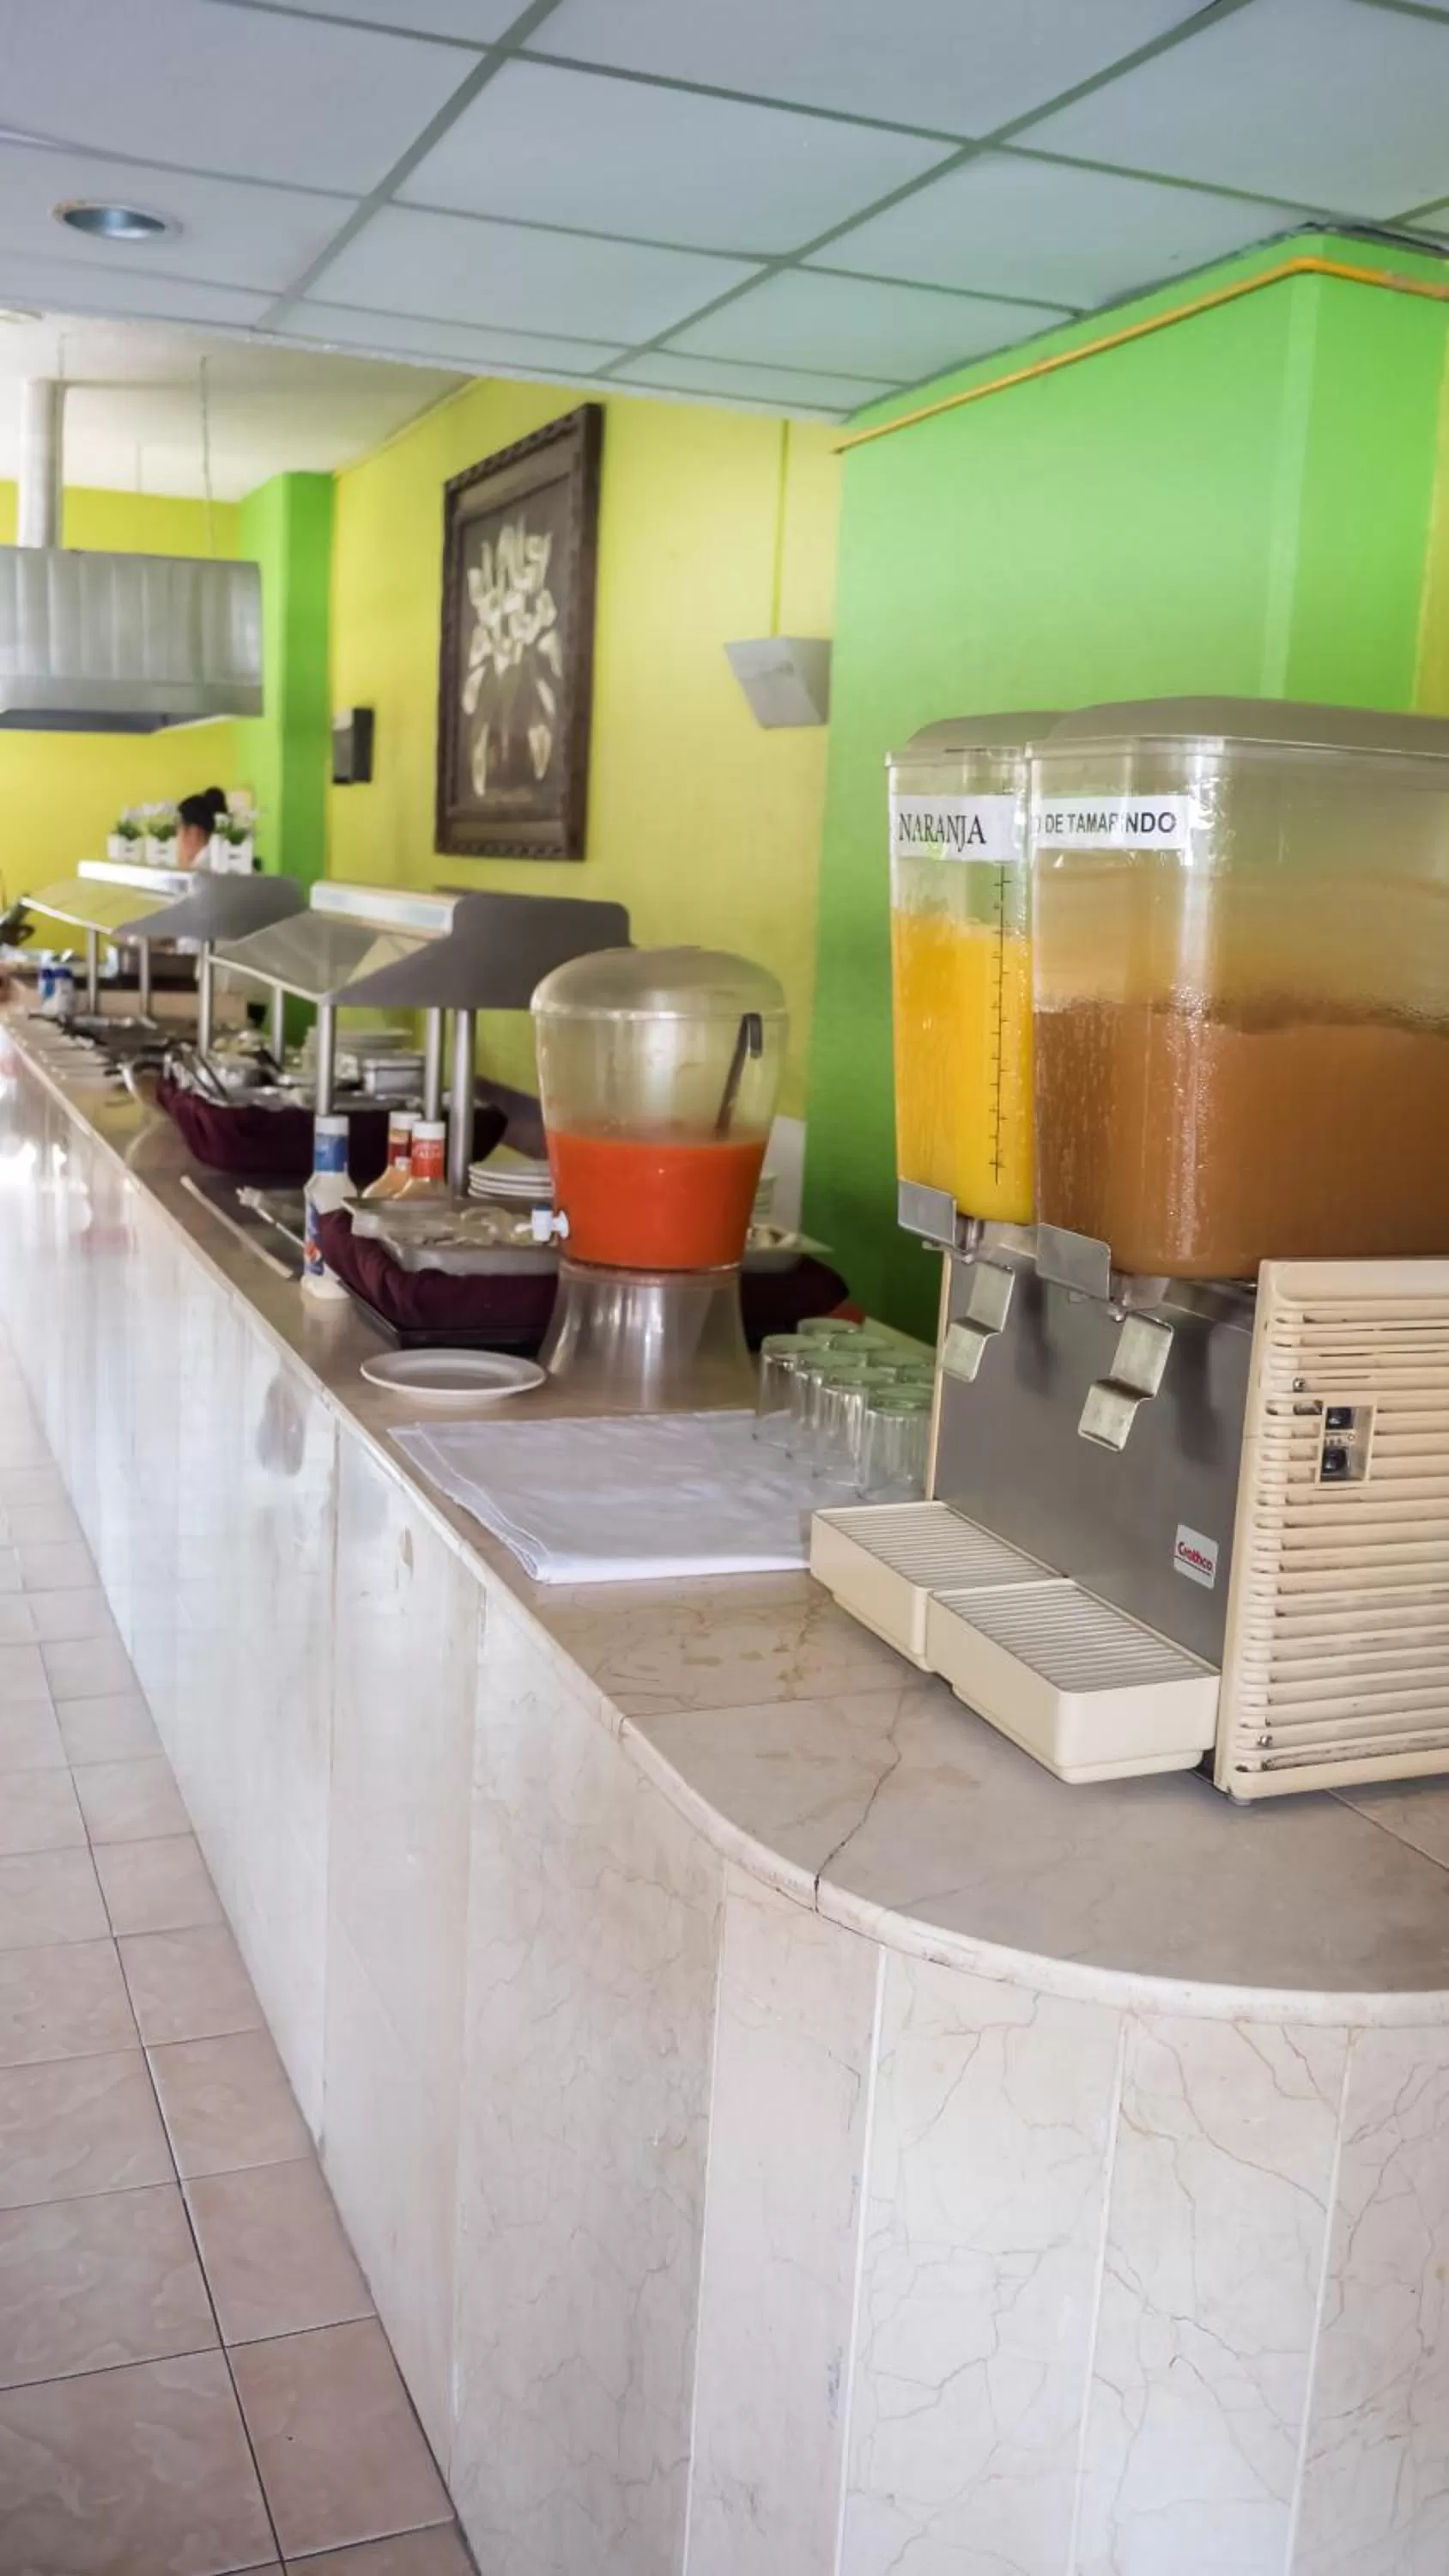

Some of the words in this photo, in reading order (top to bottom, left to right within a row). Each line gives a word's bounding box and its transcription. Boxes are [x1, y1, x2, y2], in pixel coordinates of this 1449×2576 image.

[899, 812, 986, 853] NARANJA
[1045, 812, 1064, 833] DE
[1066, 811, 1177, 834] TAMARNDO
